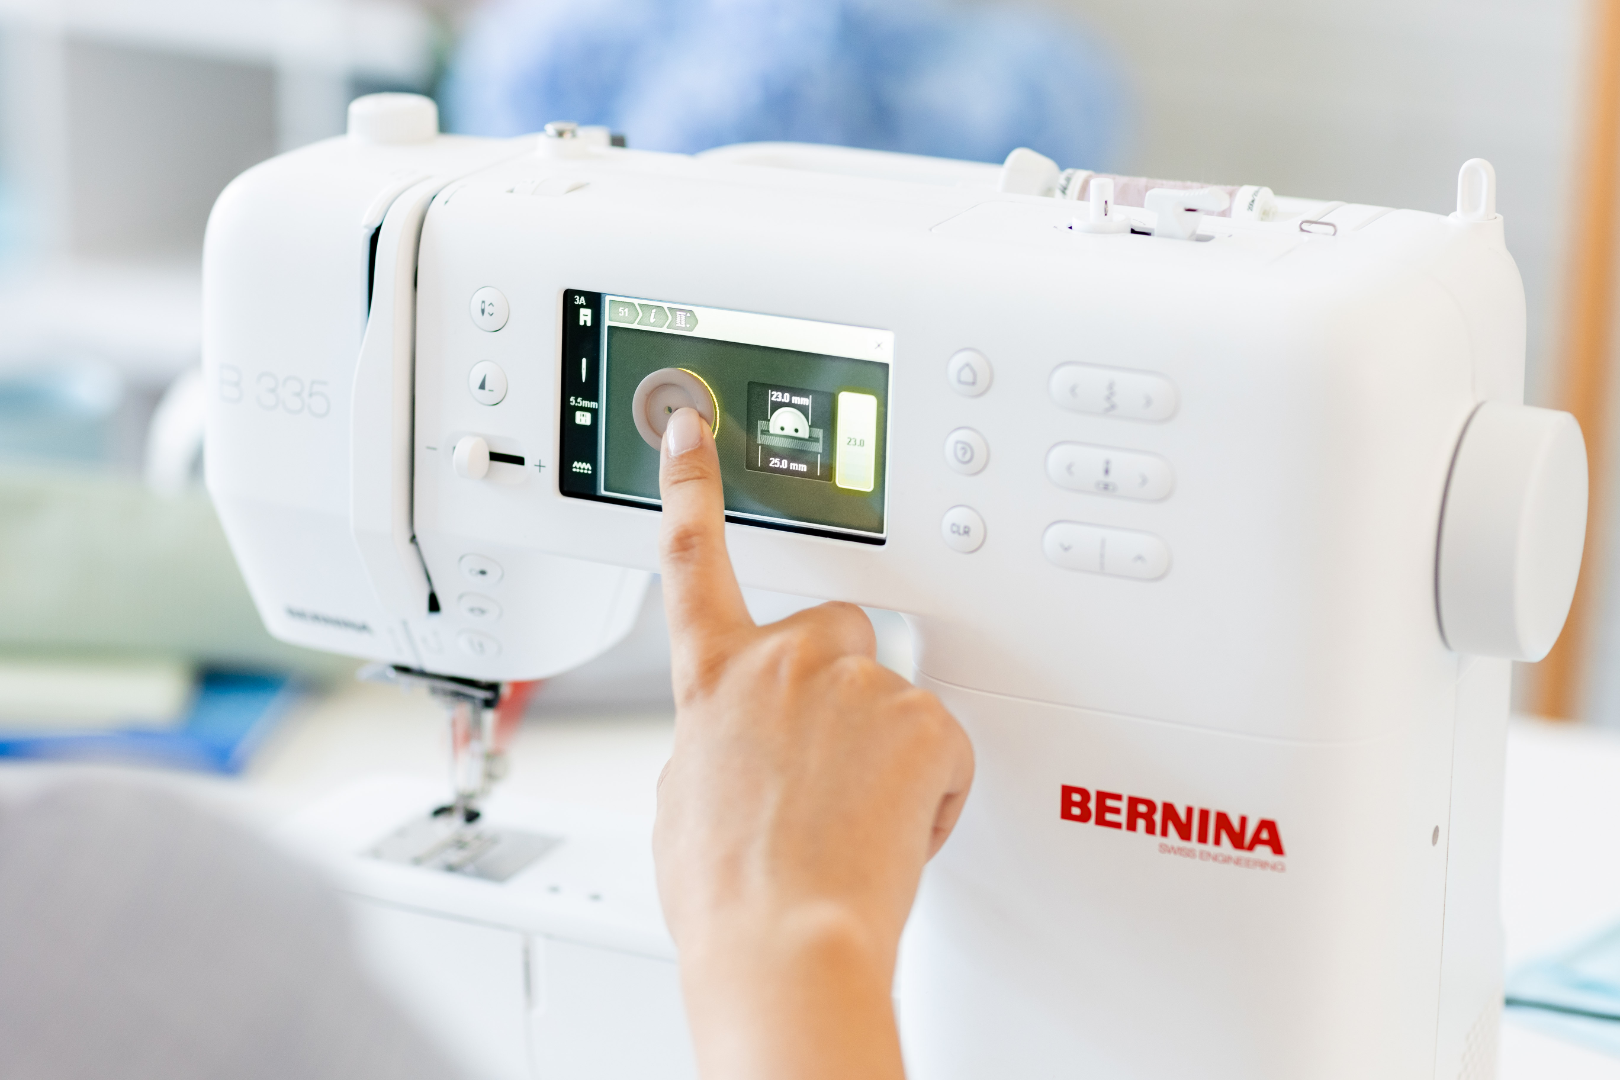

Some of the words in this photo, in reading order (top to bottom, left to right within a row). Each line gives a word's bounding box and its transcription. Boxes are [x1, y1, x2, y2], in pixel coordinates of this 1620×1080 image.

[574, 295, 586, 306] 3A
[618, 307, 629, 317] 51
[219, 362, 243, 405] B
[255, 371, 331, 419] 335
[569, 396, 598, 409] 5.5mm
[771, 391, 790, 403] 23.0
[791, 395, 810, 406] mm
[846, 436, 865, 448] 23.0
[769, 457, 788, 469] 25.0
[789, 462, 807, 472] mm
[950, 522, 971, 538] CLR
[1060, 784, 1286, 857] BERNINA
[1158, 842, 1197, 860] SWISS
[1199, 849, 1286, 873] ENGINEERING
